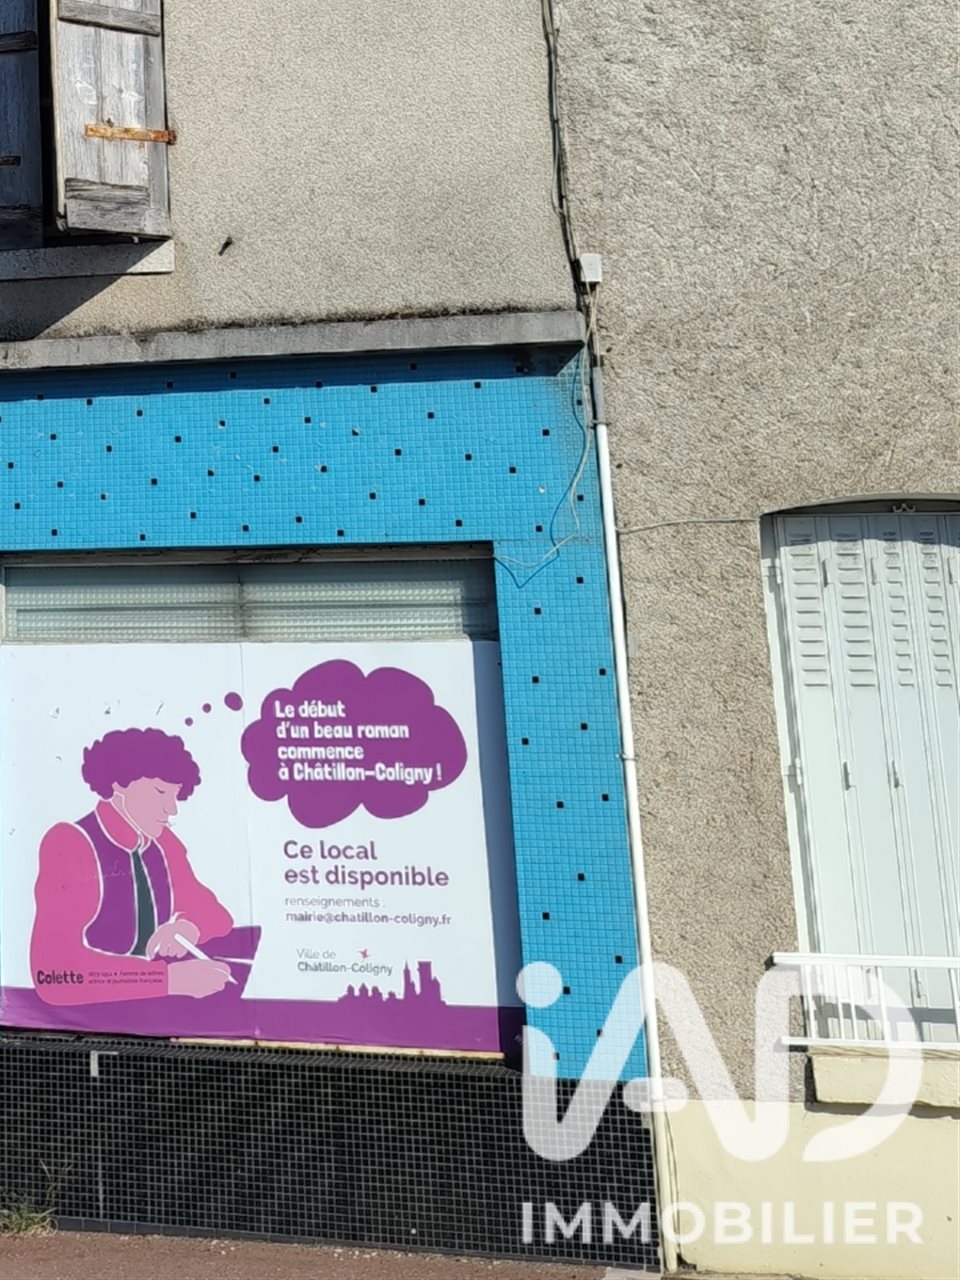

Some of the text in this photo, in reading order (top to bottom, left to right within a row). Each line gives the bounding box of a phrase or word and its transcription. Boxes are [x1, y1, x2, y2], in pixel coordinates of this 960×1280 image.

[275, 700, 346, 718] Le début
[314, 721, 353, 739] beau
[357, 724, 409, 739] roman
[277, 744, 364, 760] commence
[278, 763, 289, 781] à
[283, 839, 378, 860] Ce local
[284, 865, 450, 891] est disponible
[285, 896, 380, 909] renseignements
[286, 911, 452, 928] mairie@chatillon-coligny.fr
[296, 948, 336, 960] Ville de
[37, 970, 84, 985] Colette
